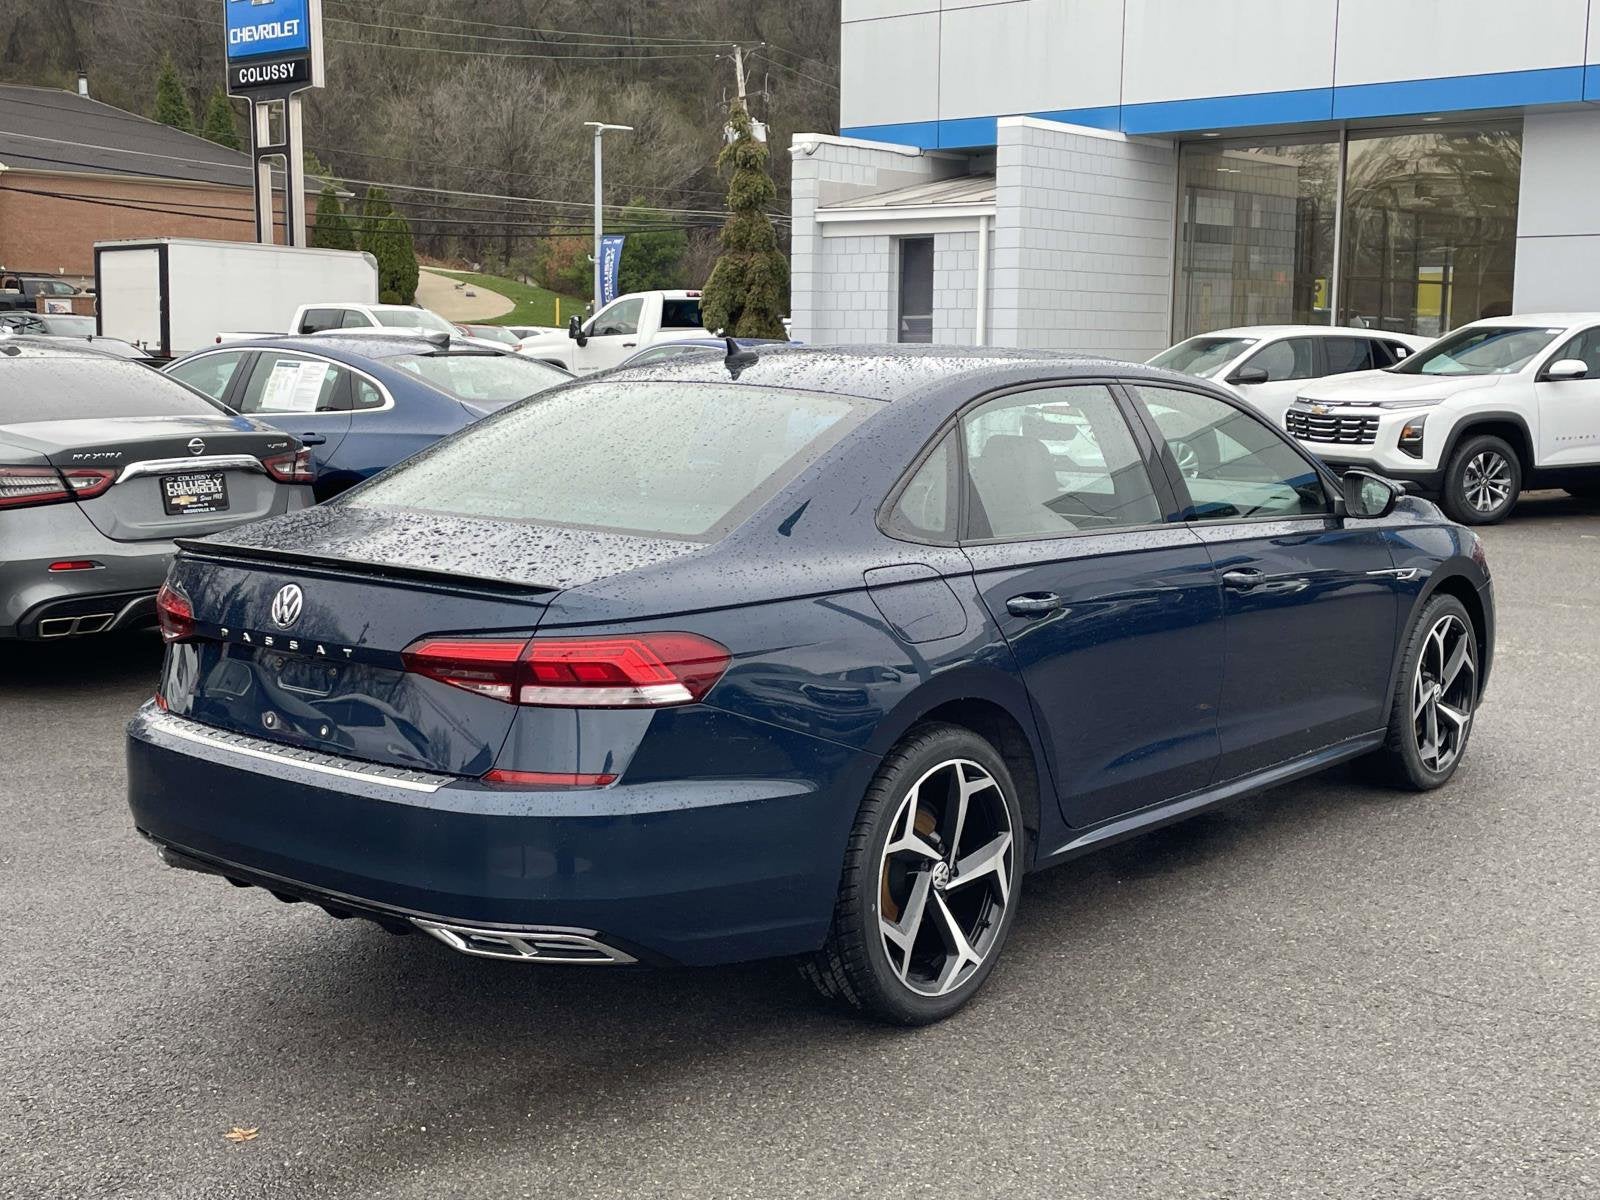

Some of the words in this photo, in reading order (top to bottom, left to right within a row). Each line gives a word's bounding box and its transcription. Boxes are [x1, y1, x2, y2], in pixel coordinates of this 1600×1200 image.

[229, 19, 300, 44] CHEVROLET
[239, 62, 295, 83] COLUSSY
[167, 479, 221, 490] COLUSSY
[168, 486, 222, 496] CHEVROLET
[220, 627, 353, 658] PASSAT
